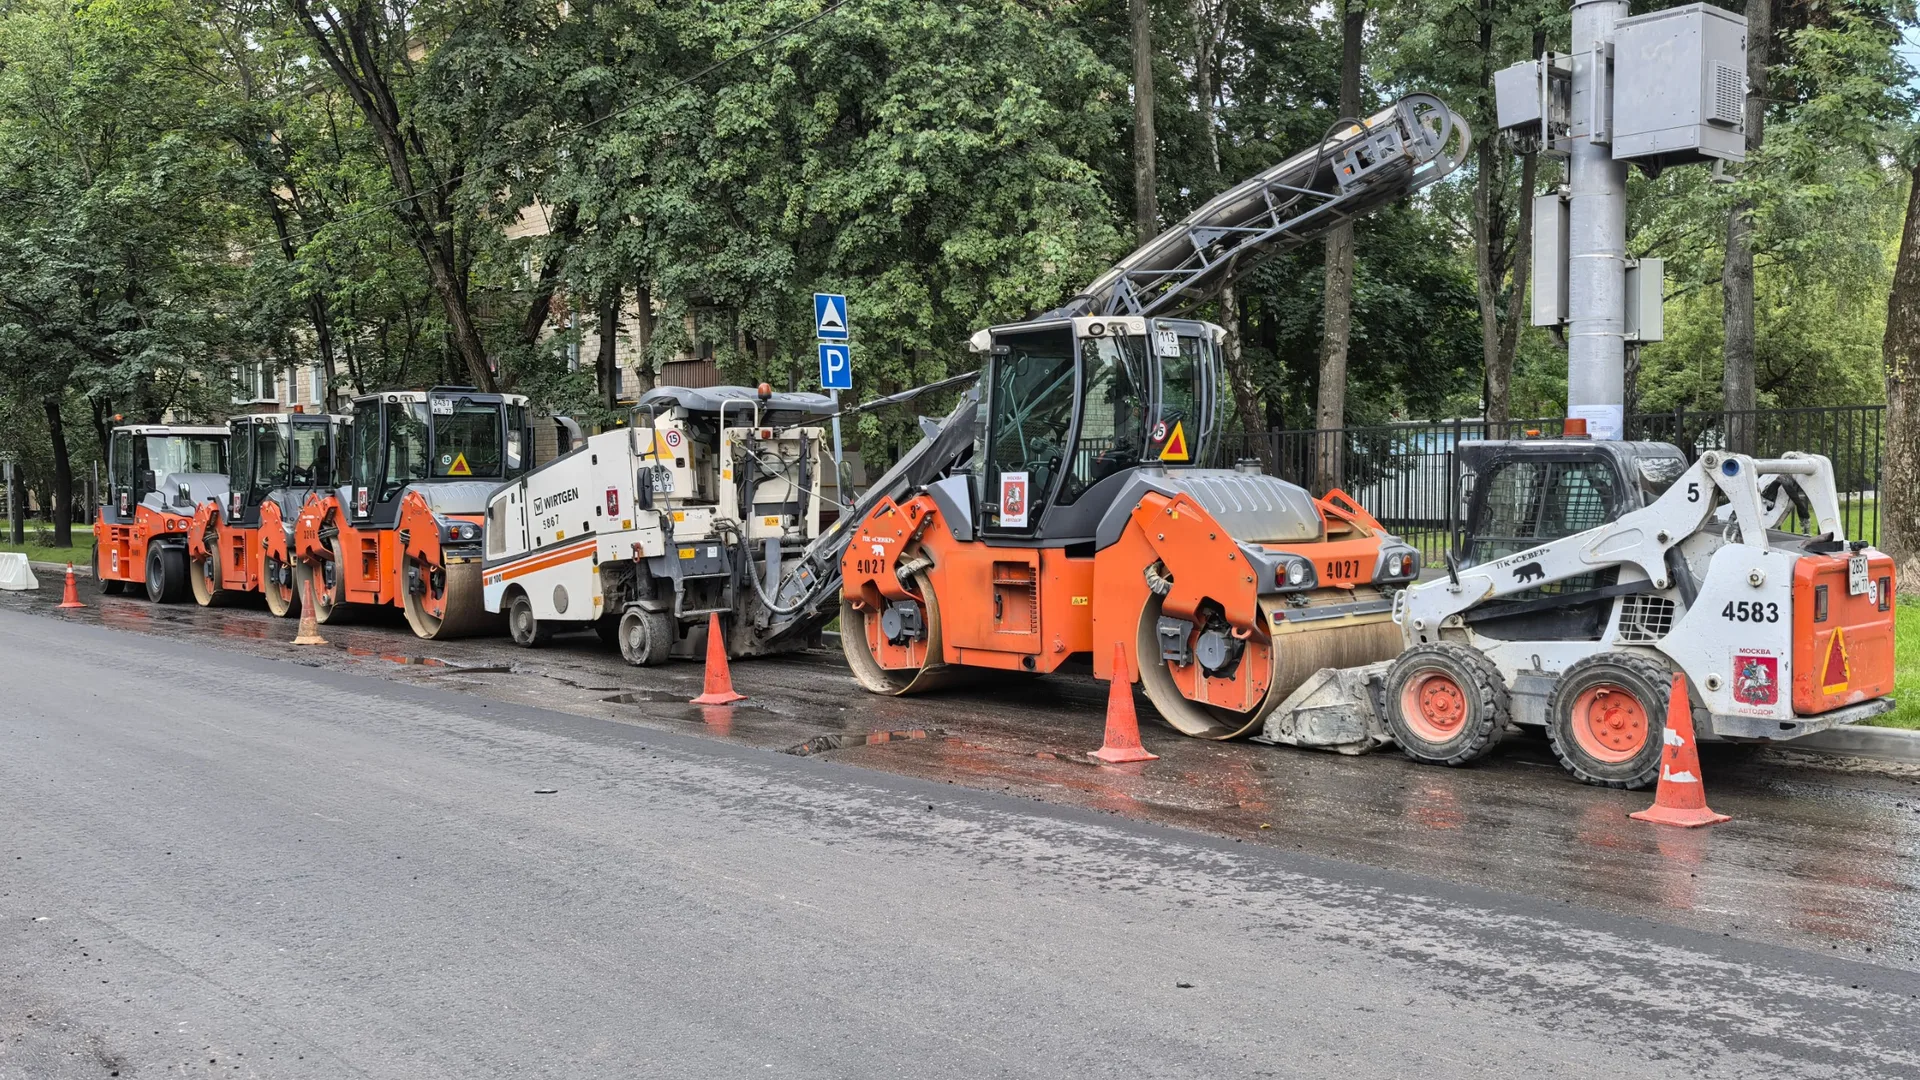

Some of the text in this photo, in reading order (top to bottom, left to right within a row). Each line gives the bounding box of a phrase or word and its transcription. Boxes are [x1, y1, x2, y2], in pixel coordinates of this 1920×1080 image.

[1169, 346, 1178, 356] 77
[827, 349, 844, 384] P
[669, 434, 678, 443] 15
[650, 473, 670, 482] 289
[544, 487, 579, 509] WIRTGEN
[1687, 482, 1700, 503] 5
[910, 505, 916, 519] 3
[543, 514, 559, 530] 5867
[857, 559, 885, 574] 4027
[1326, 560, 1359, 579] 4027
[1851, 558, 1867, 575] 2851
[1862, 578, 1868, 591] 77
[1870, 585, 1876, 599] 25
[1721, 600, 1779, 623] 4583
[1739, 647, 1771, 655] МОСКВА
[1738, 707, 1773, 716] АВТОДОР
